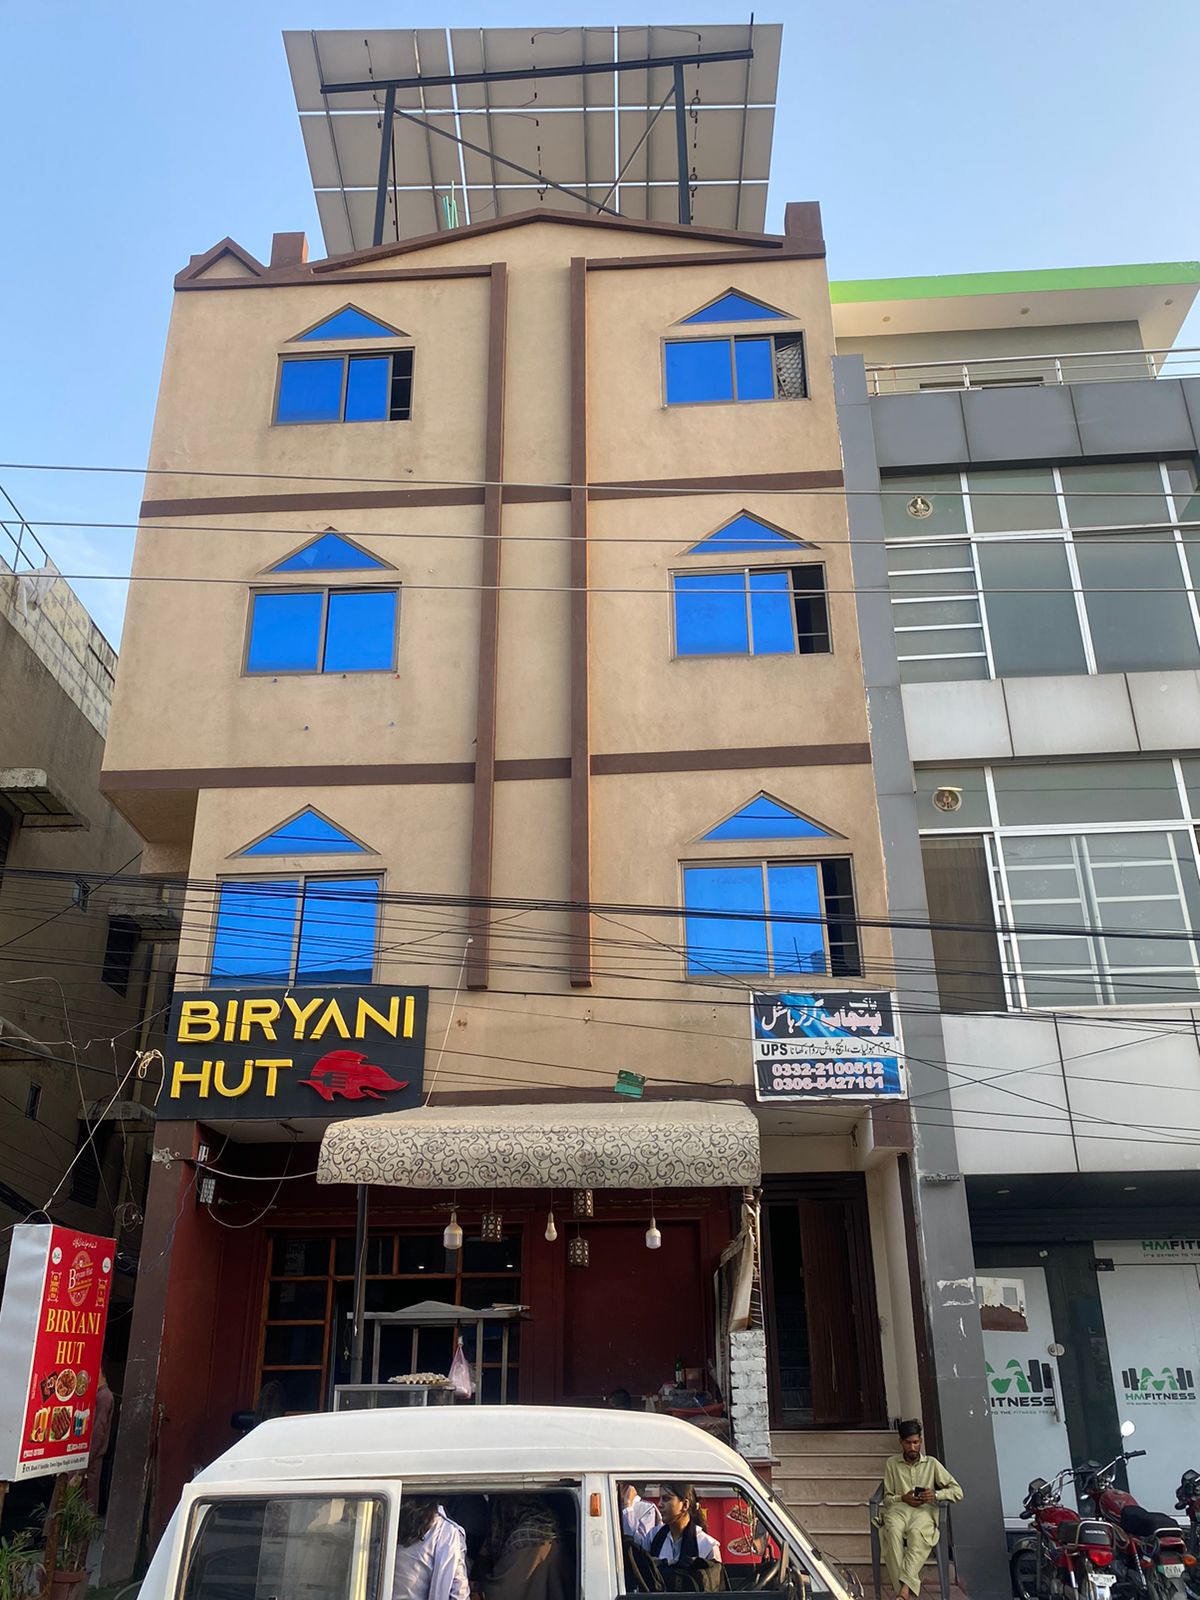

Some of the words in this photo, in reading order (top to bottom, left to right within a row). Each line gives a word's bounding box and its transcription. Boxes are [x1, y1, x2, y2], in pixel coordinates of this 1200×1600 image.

[177, 995, 415, 1042] BIRYANI
[820, 1006, 883, 1035] پنجاب
[761, 1044, 788, 1056] UPS
[772, 1062, 884, 1076] 0332-2100512
[170, 1059, 293, 1099] HUT
[773, 1076, 884, 1090] 0306-5427191
[45, 1308, 101, 1334] BIRYANI
[55, 1341, 85, 1365] HUT
[991, 1396, 1055, 1407] ITNESS
[1125, 1392, 1197, 1401] HMFITNESS
